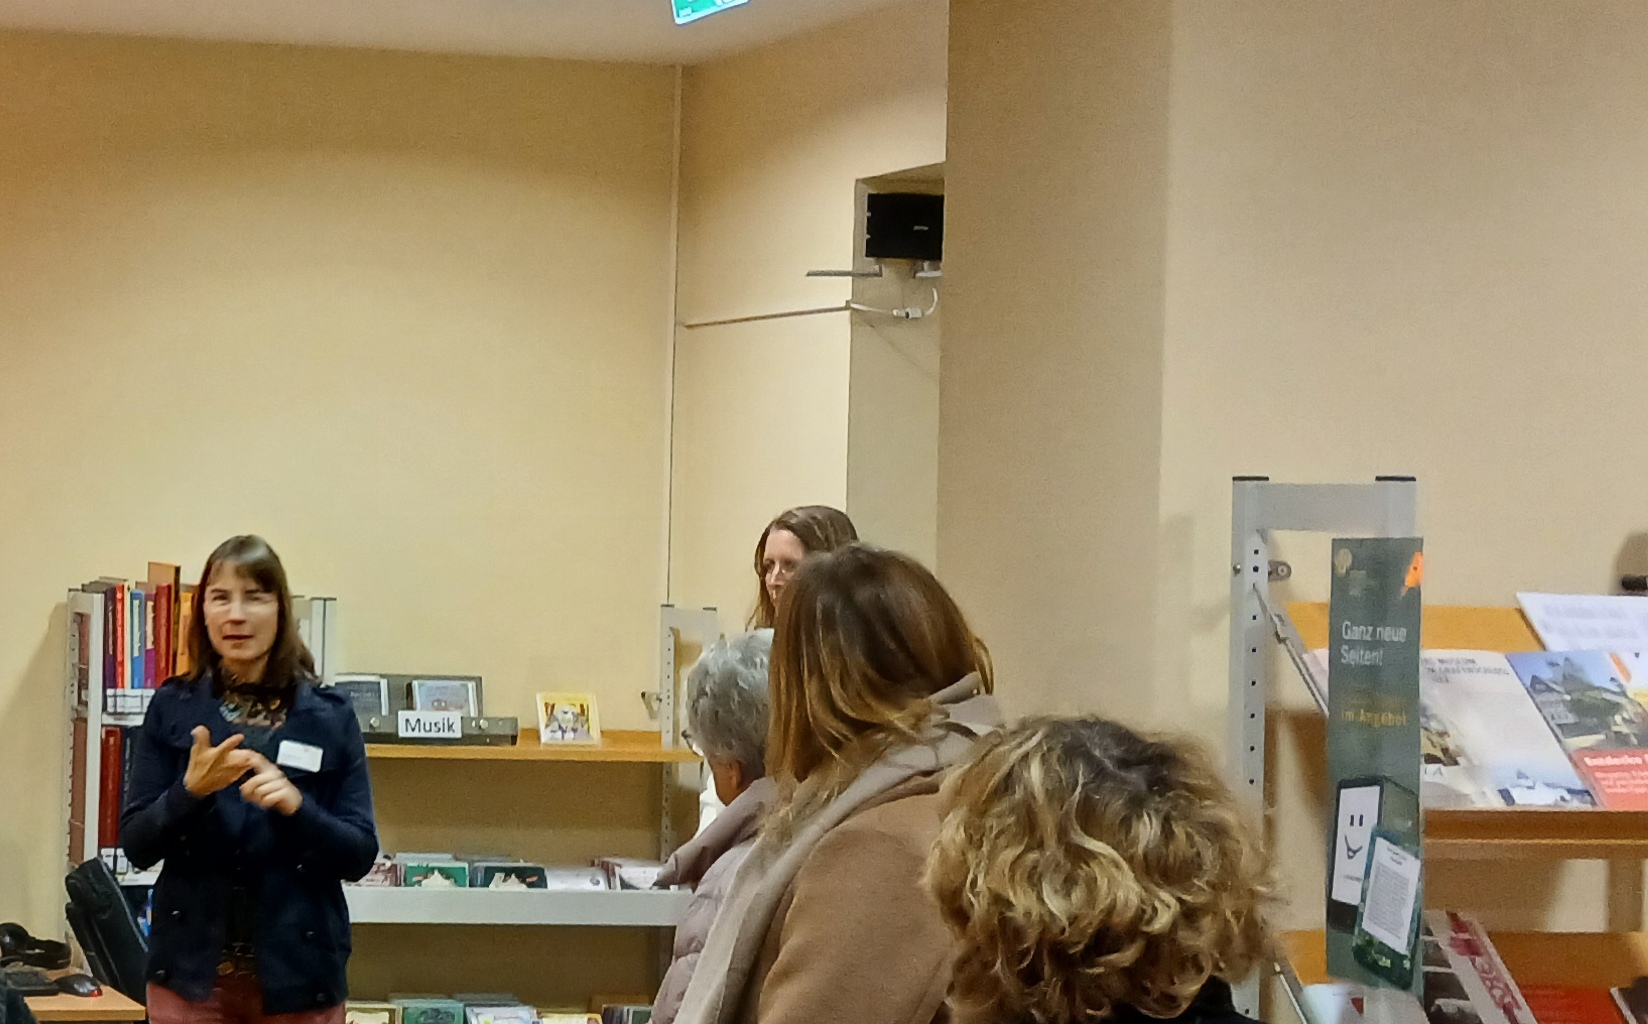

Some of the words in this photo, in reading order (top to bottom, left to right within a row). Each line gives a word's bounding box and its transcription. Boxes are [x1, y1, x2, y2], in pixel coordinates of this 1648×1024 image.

[1342, 621, 1374, 641] Ganz
[1376, 626, 1407, 643] neue
[405, 717, 456, 733] Musik
